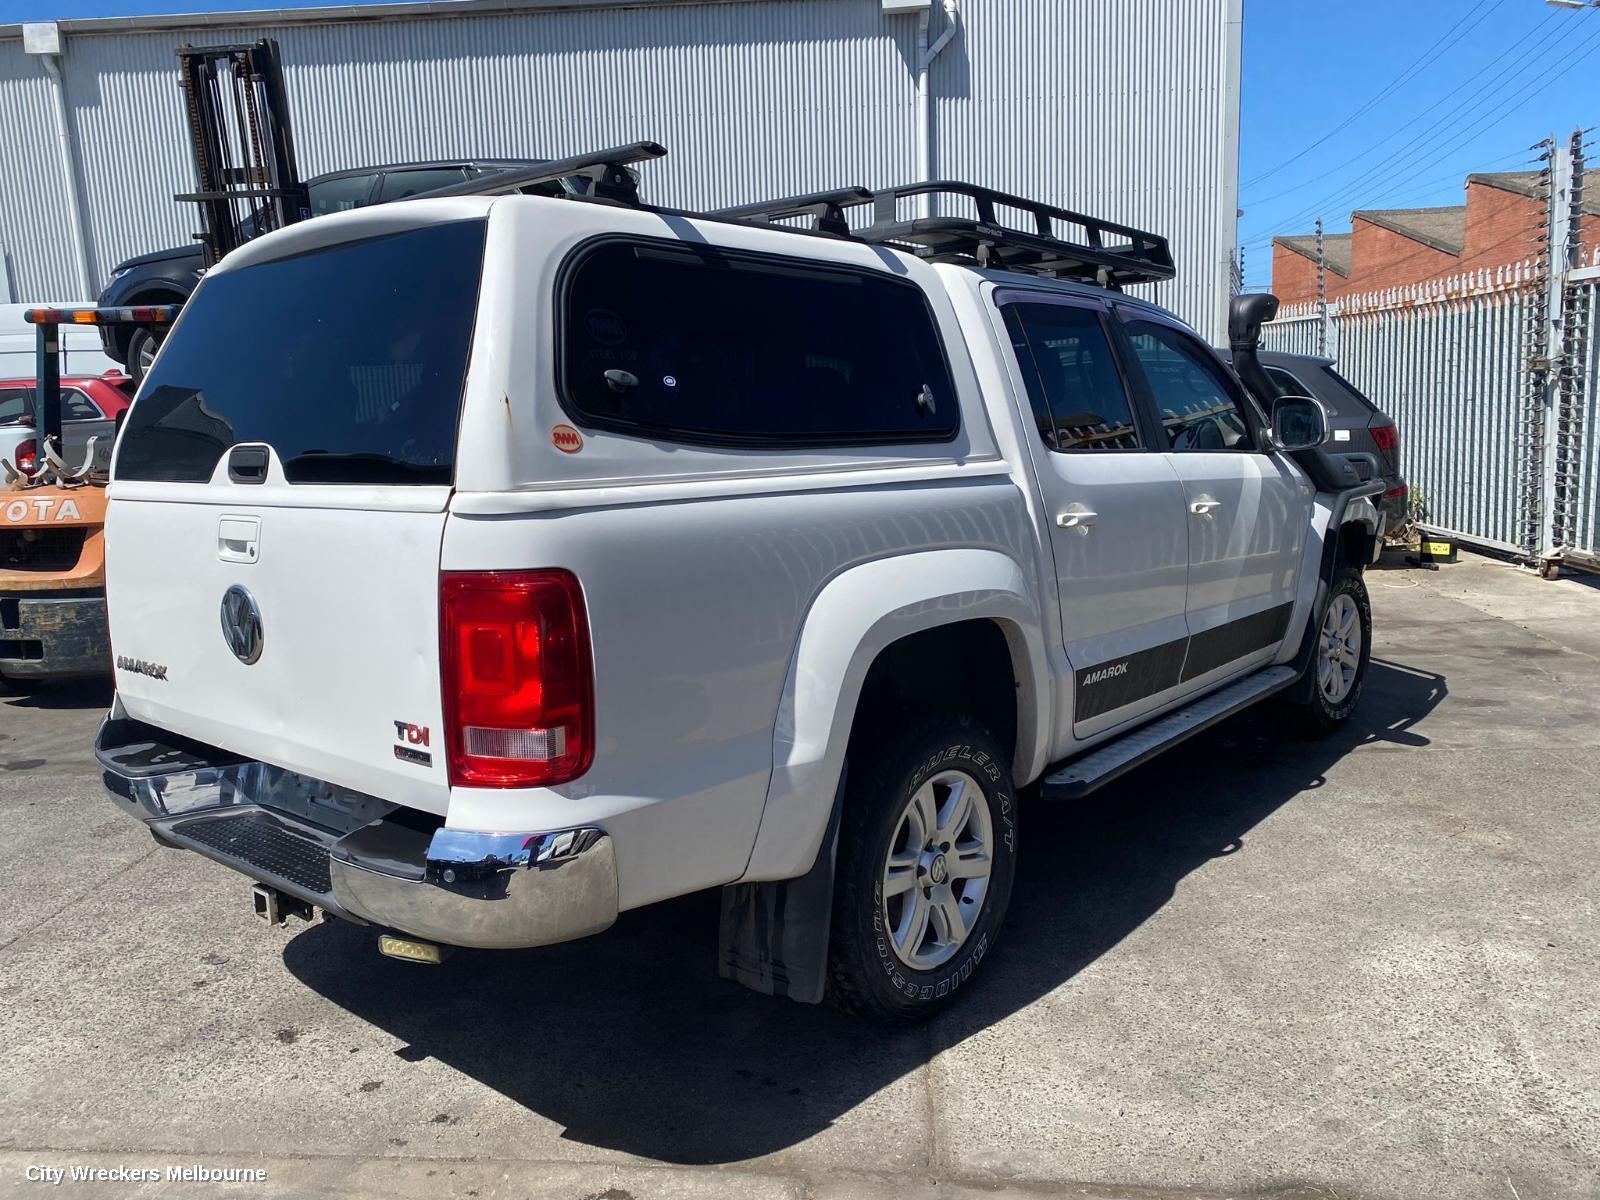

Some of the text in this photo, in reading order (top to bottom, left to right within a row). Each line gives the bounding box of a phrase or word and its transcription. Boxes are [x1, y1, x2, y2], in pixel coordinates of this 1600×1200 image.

[117, 655, 169, 682] AMAROK
[1082, 662, 1128, 687] AMAROK
[393, 720, 430, 747] TDI
[997, 791, 1015, 854] A/T
